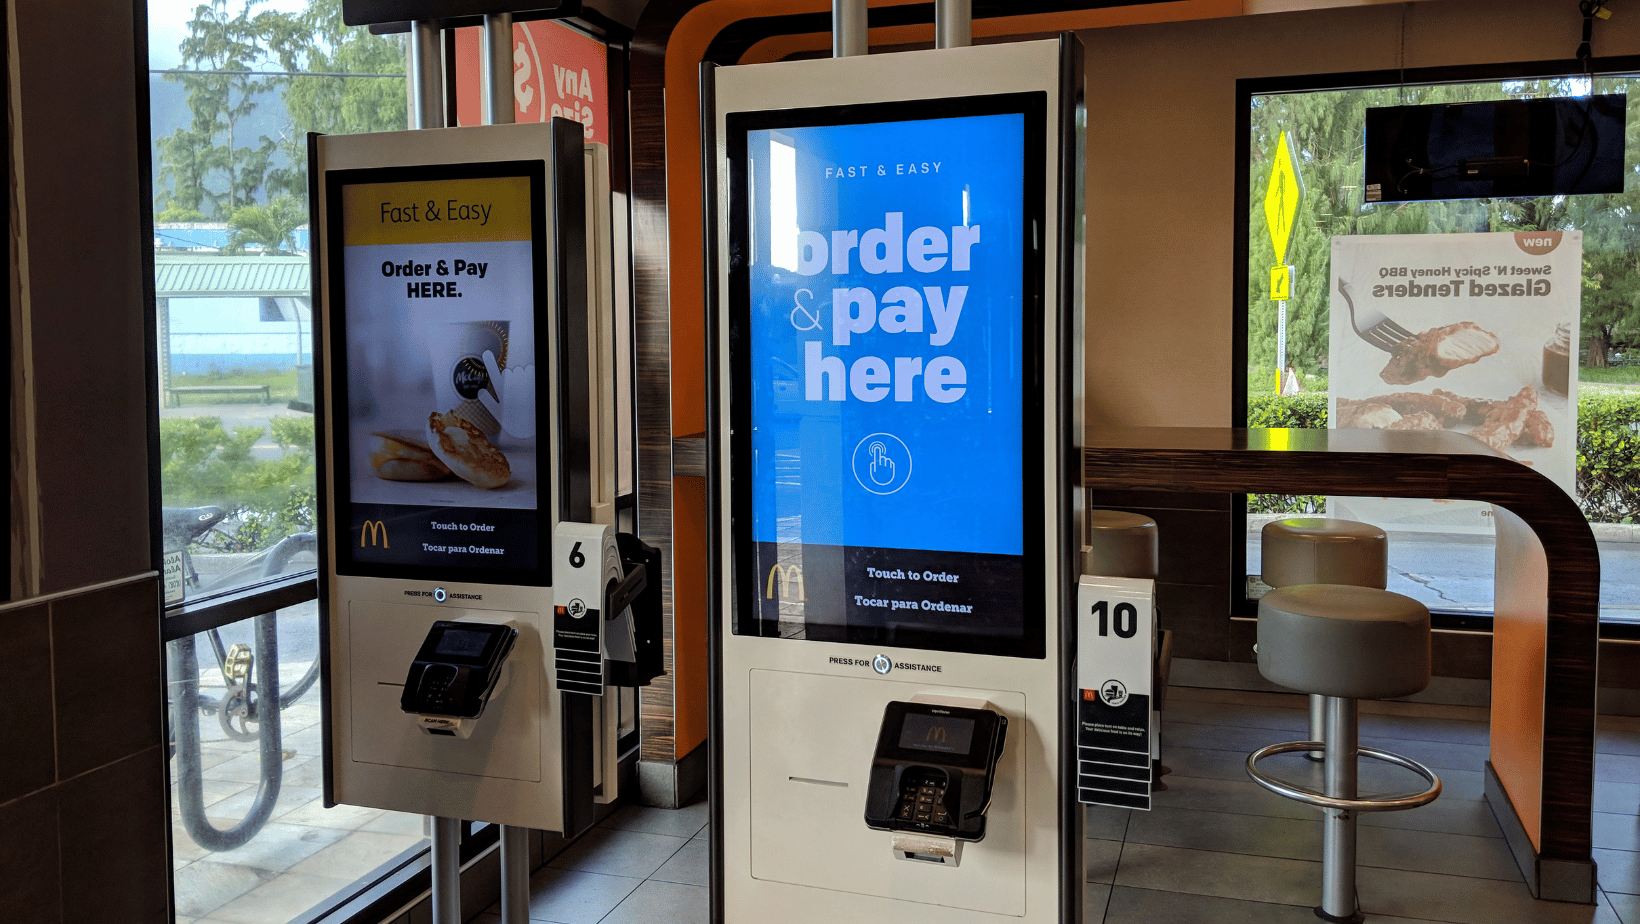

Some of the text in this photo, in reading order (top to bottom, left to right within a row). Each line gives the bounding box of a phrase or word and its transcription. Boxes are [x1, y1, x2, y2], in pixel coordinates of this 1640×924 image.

[825, 162, 942, 179] FAST & EASY
[380, 199, 492, 226] Fast & Easy
[795, 212, 980, 276] order
[381, 259, 488, 279] Order & Pay
[407, 282, 463, 299] HERE.
[790, 286, 969, 346] & pay
[805, 341, 967, 403] here
[430, 521, 495, 532] Touch to Order
[422, 543, 504, 555] Tocar para Ordenar
[568, 541, 586, 568] 6
[867, 567, 959, 583] Touch to Order
[854, 595, 973, 613] Tocar para Ordenar
[1091, 600, 1138, 639] 10
[829, 656, 942, 673] PRESS FOR ASSISTANCE
